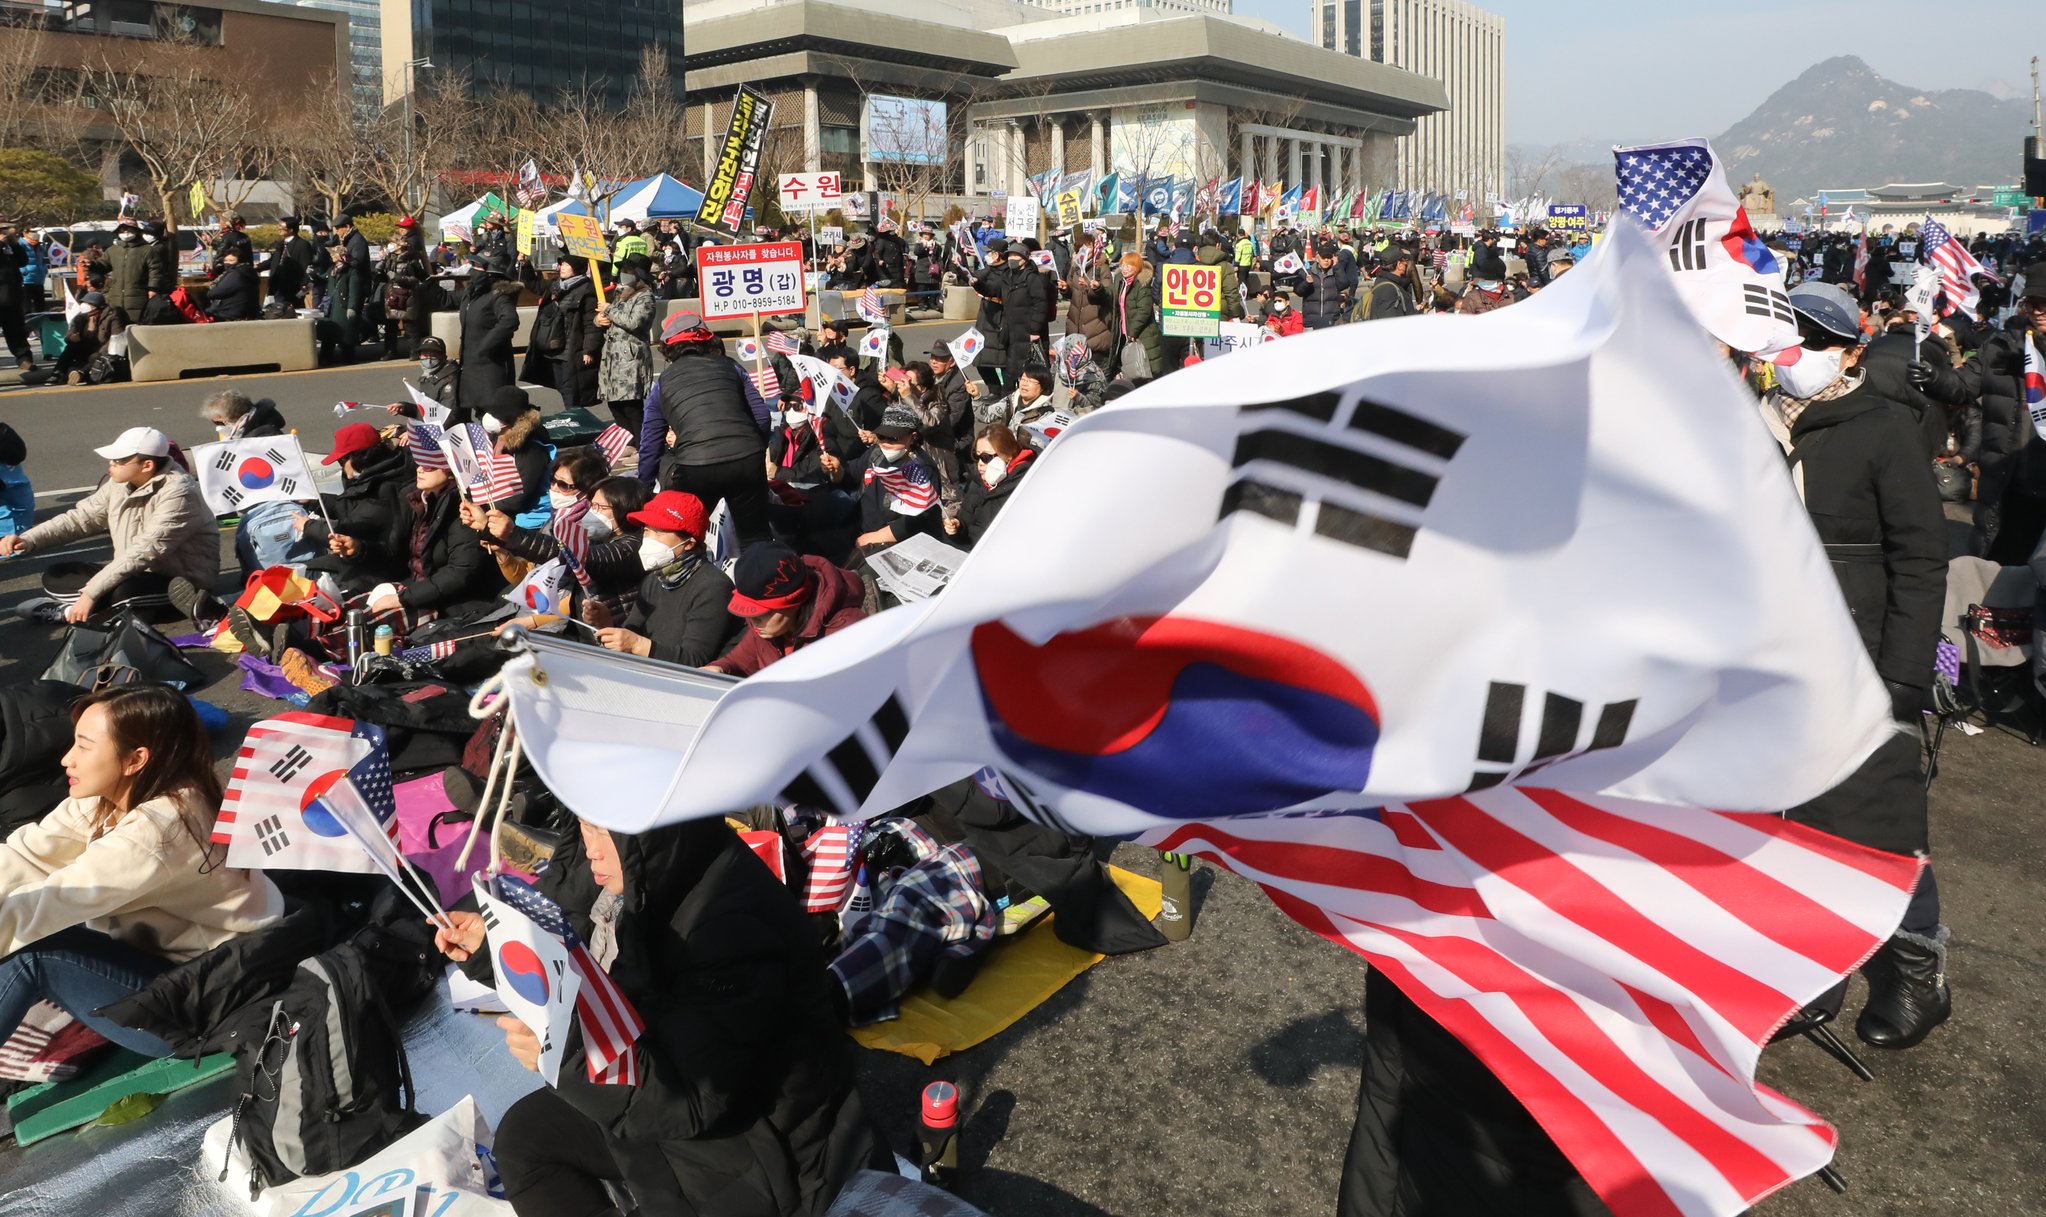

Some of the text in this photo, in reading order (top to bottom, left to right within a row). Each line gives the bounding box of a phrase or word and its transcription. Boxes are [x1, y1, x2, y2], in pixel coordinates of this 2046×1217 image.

[706, 246, 797, 262] 자원봉사자를 찾습니다.
[769, 272, 797, 292] (갑)
[1166, 268, 1216, 307] 안양
[714, 295, 796, 312] H.P 010-8959-5184
[1209, 334, 1252, 352] 파주시
